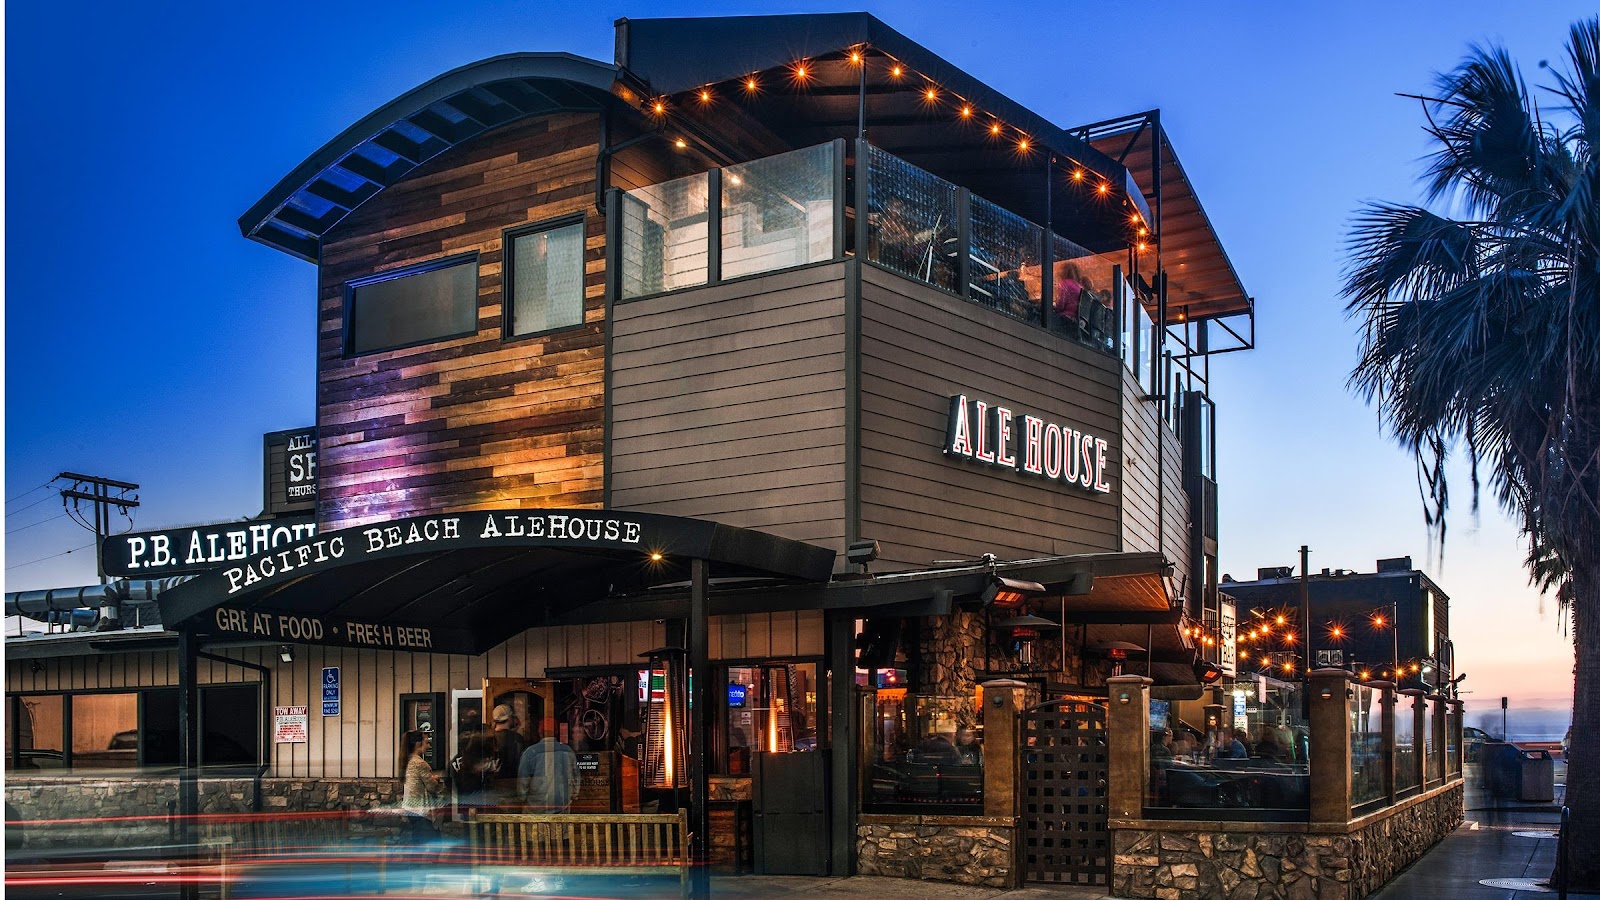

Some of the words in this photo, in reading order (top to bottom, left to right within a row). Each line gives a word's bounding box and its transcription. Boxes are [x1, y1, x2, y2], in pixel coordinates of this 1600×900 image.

[952, 394, 1015, 467] ALE
[1024, 414, 1110, 493] HOUSE
[127, 534, 177, 569] P.B.
[222, 536, 345, 594] PACIFIC
[363, 517, 461, 553] BEACH
[480, 513, 641, 544] ALEHOUSE
[215, 607, 272, 636] GREAT
[278, 615, 323, 640] FOOD
[346, 621, 393, 646] FRESH
[397, 626, 432, 648] BEER
[276, 707, 289, 715] TOW
[290, 707, 305, 715] AWAY
